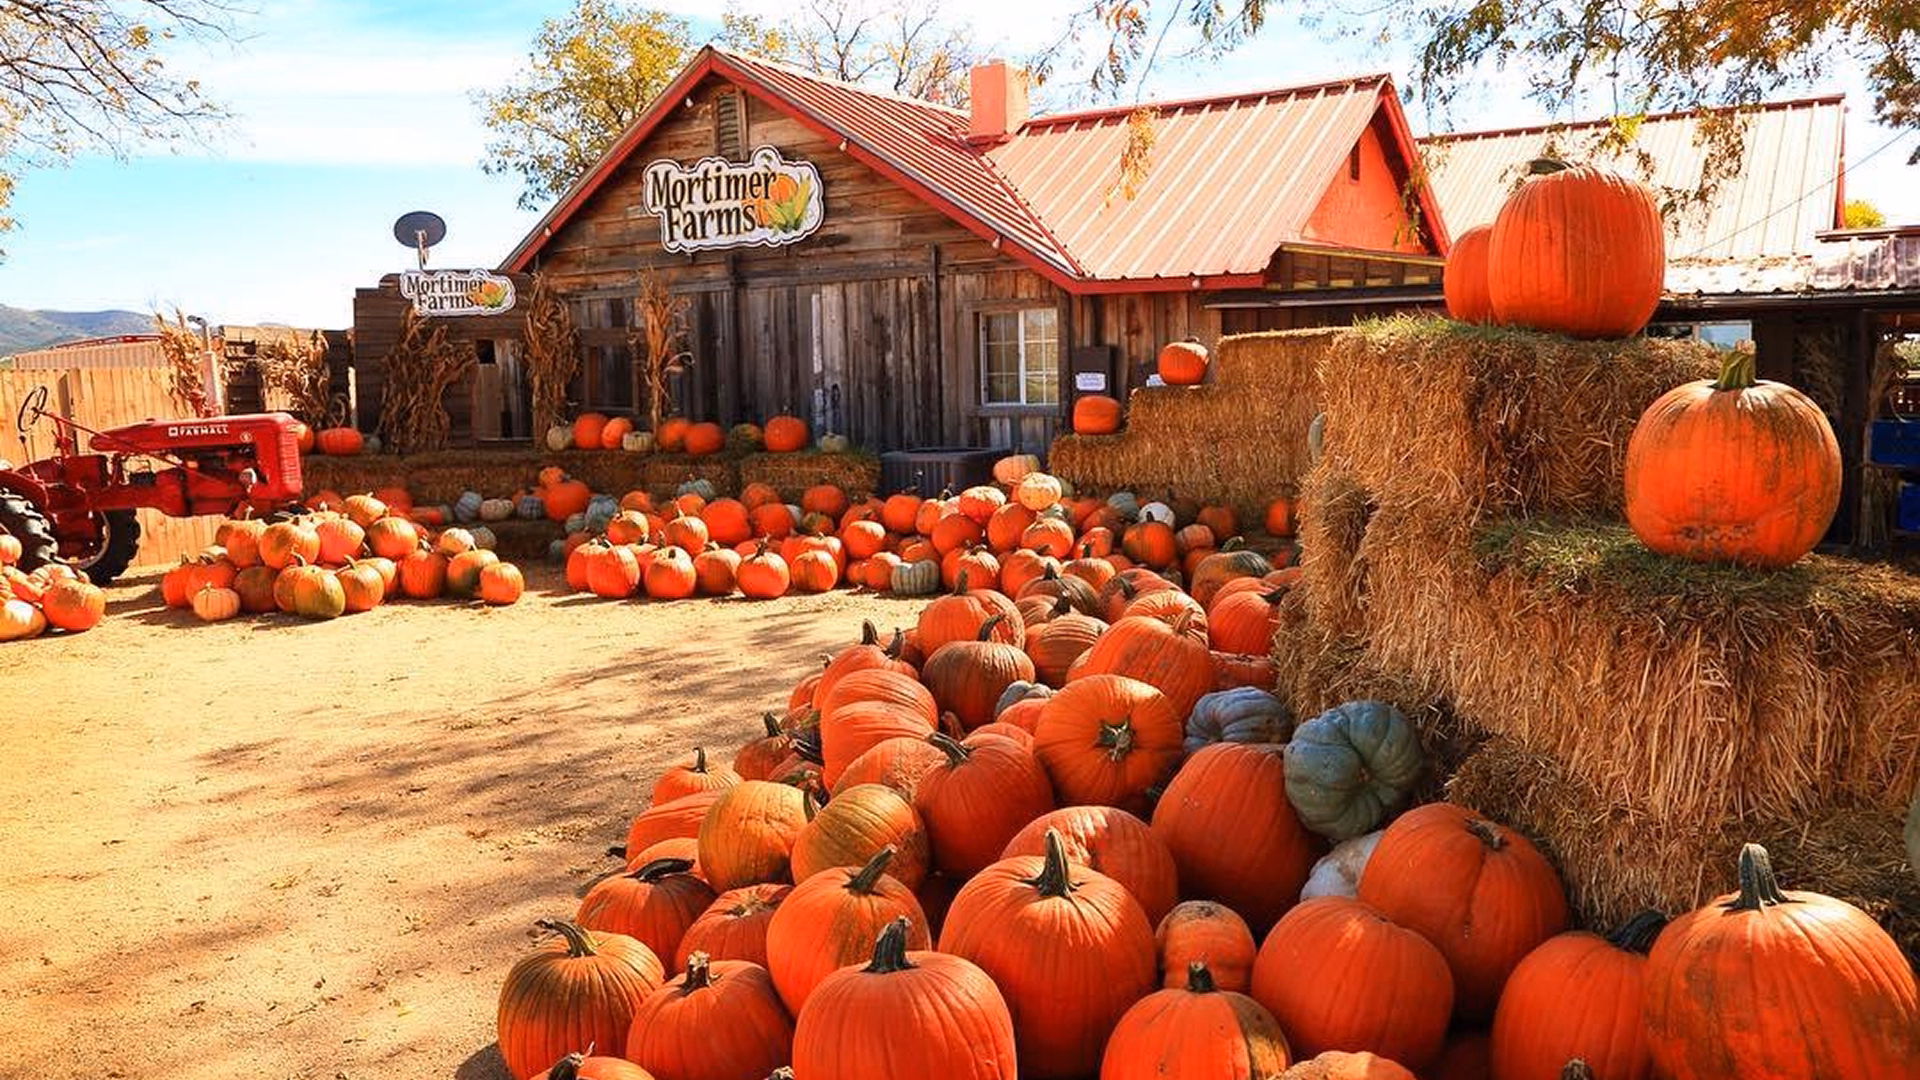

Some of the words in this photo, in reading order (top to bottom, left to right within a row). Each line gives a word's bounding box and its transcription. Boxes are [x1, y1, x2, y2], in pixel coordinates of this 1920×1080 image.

[651, 165, 777, 208] Mortimer
[666, 204, 756, 243] Farms
[407, 275, 486, 295] Mortimer
[418, 293, 475, 311] Farms
[180, 426, 229, 436] FARMALL
